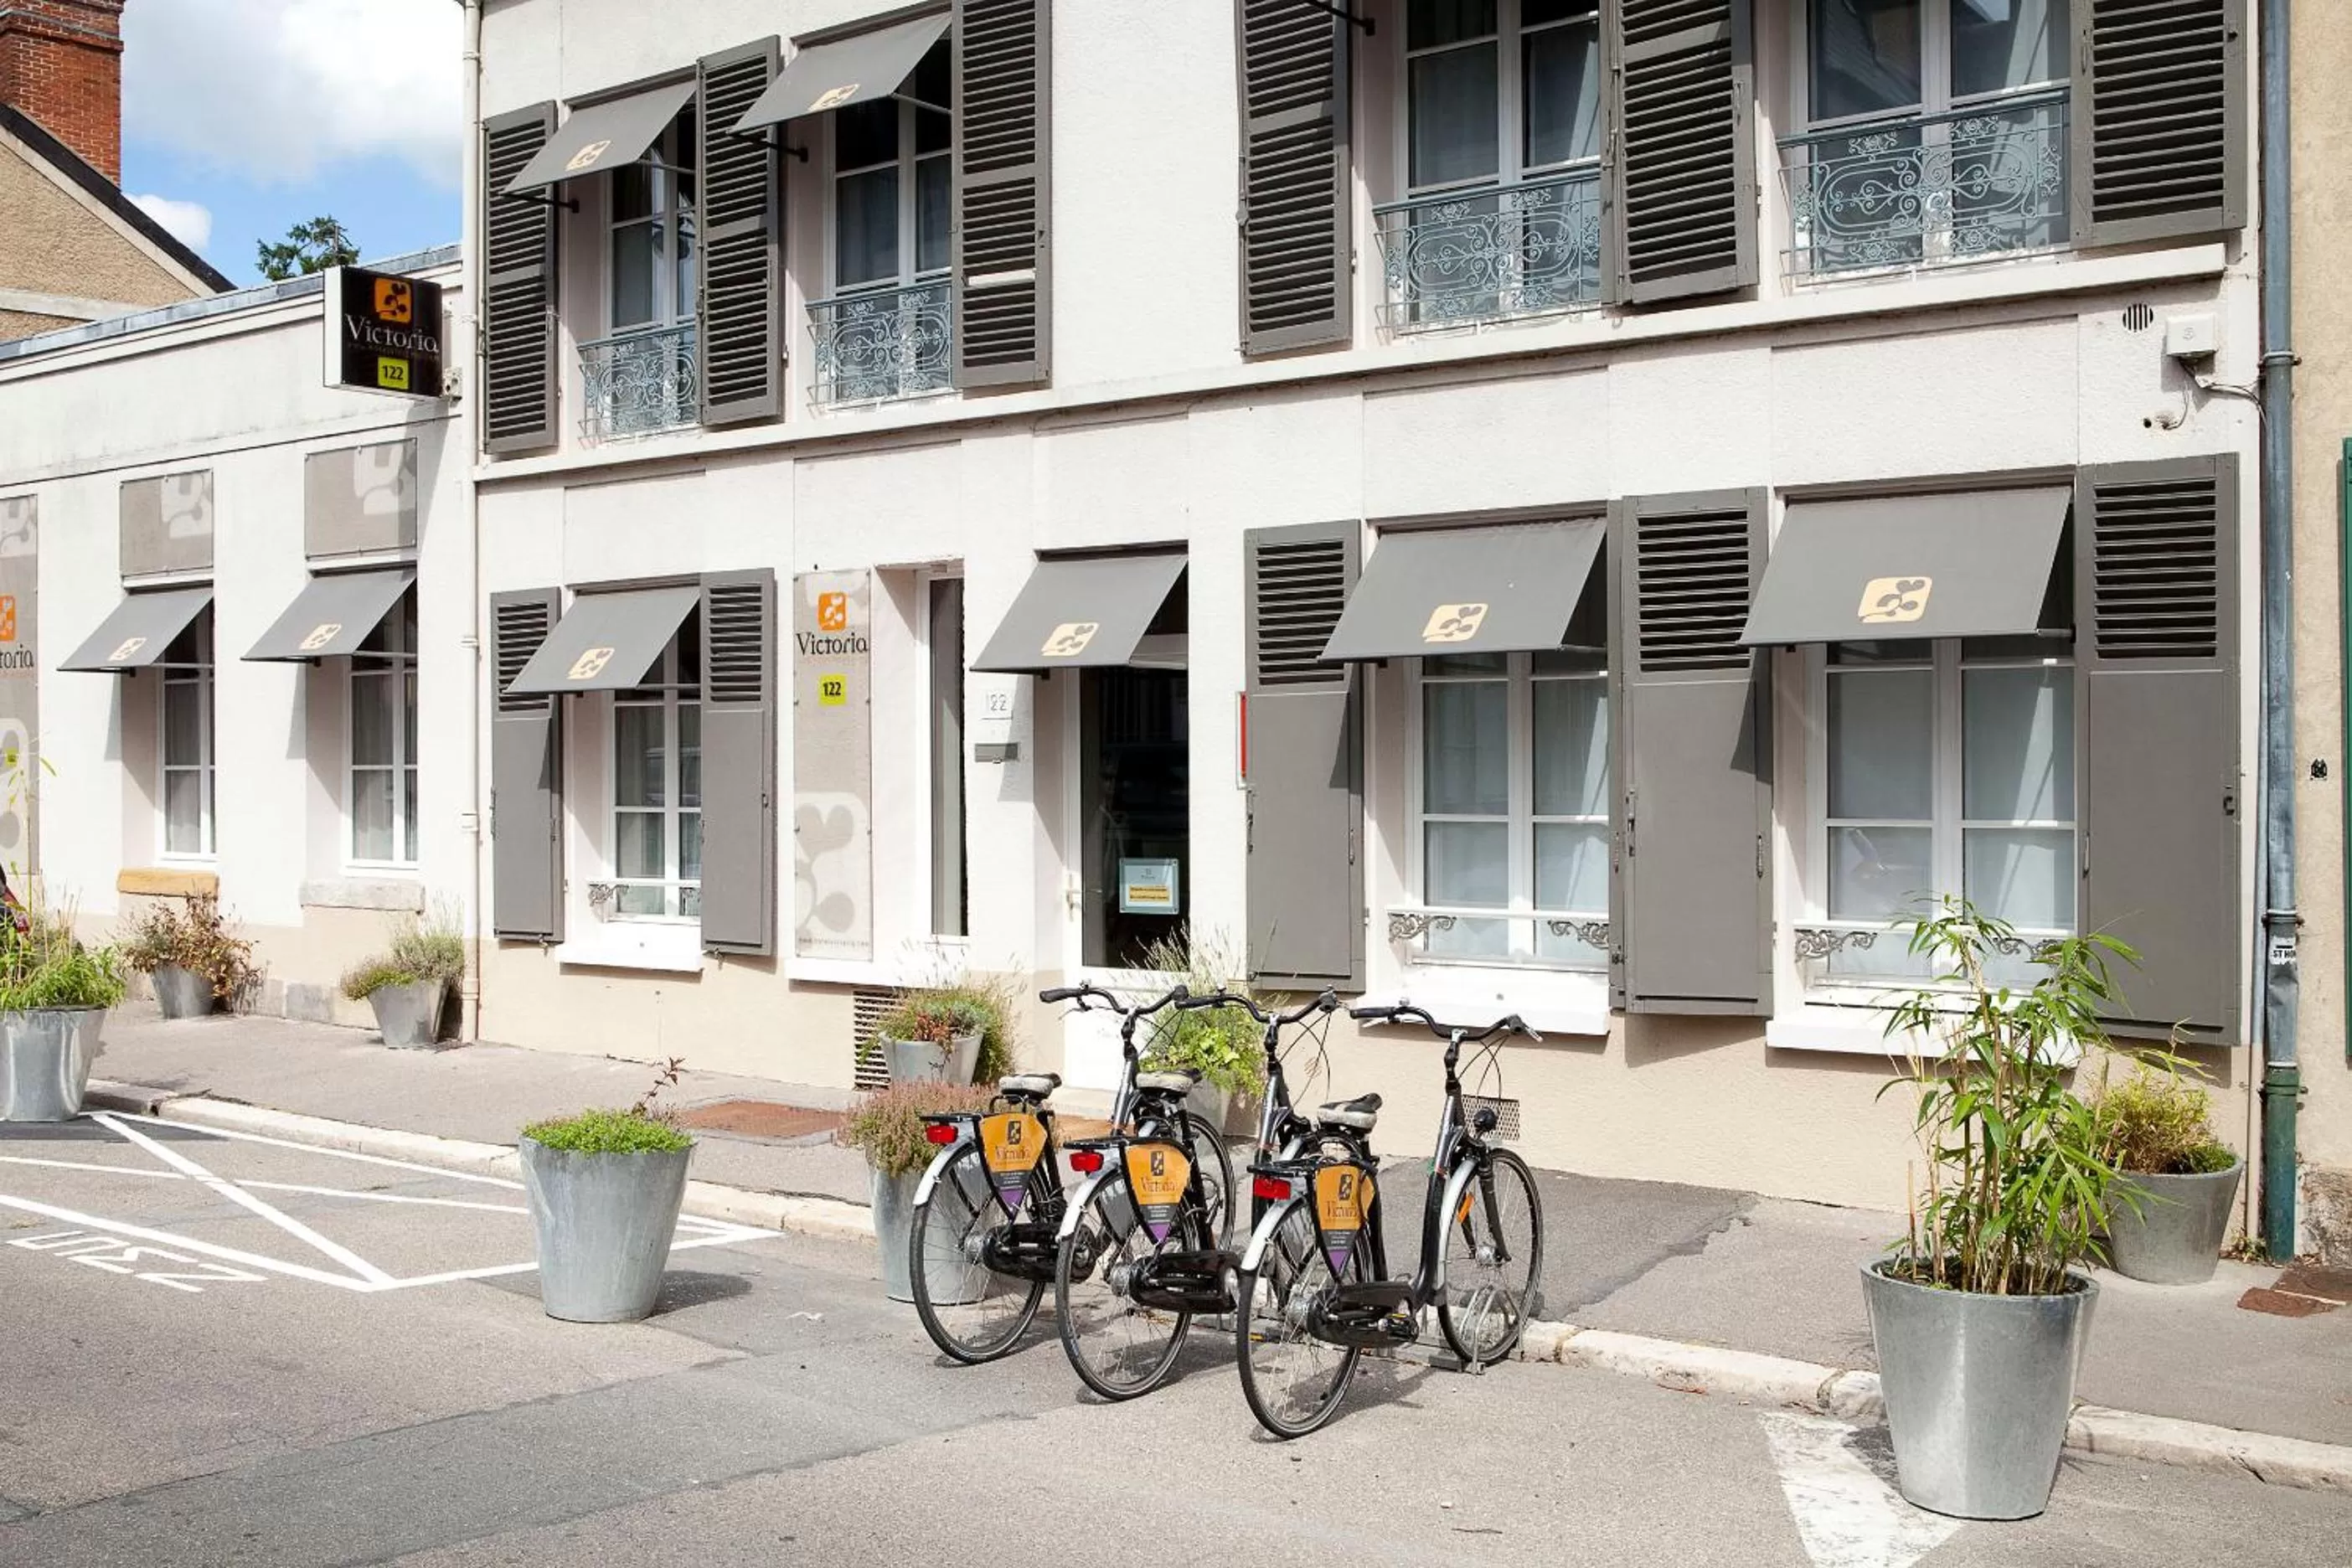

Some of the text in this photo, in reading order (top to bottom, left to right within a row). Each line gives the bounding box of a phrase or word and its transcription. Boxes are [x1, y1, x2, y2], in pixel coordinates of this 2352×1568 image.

[345, 312, 440, 353] Victoria
[382, 364, 404, 380] 122
[796, 632, 868, 656] Victoria
[823, 681, 842, 697] 122
[985, 694, 1008, 711] 22
